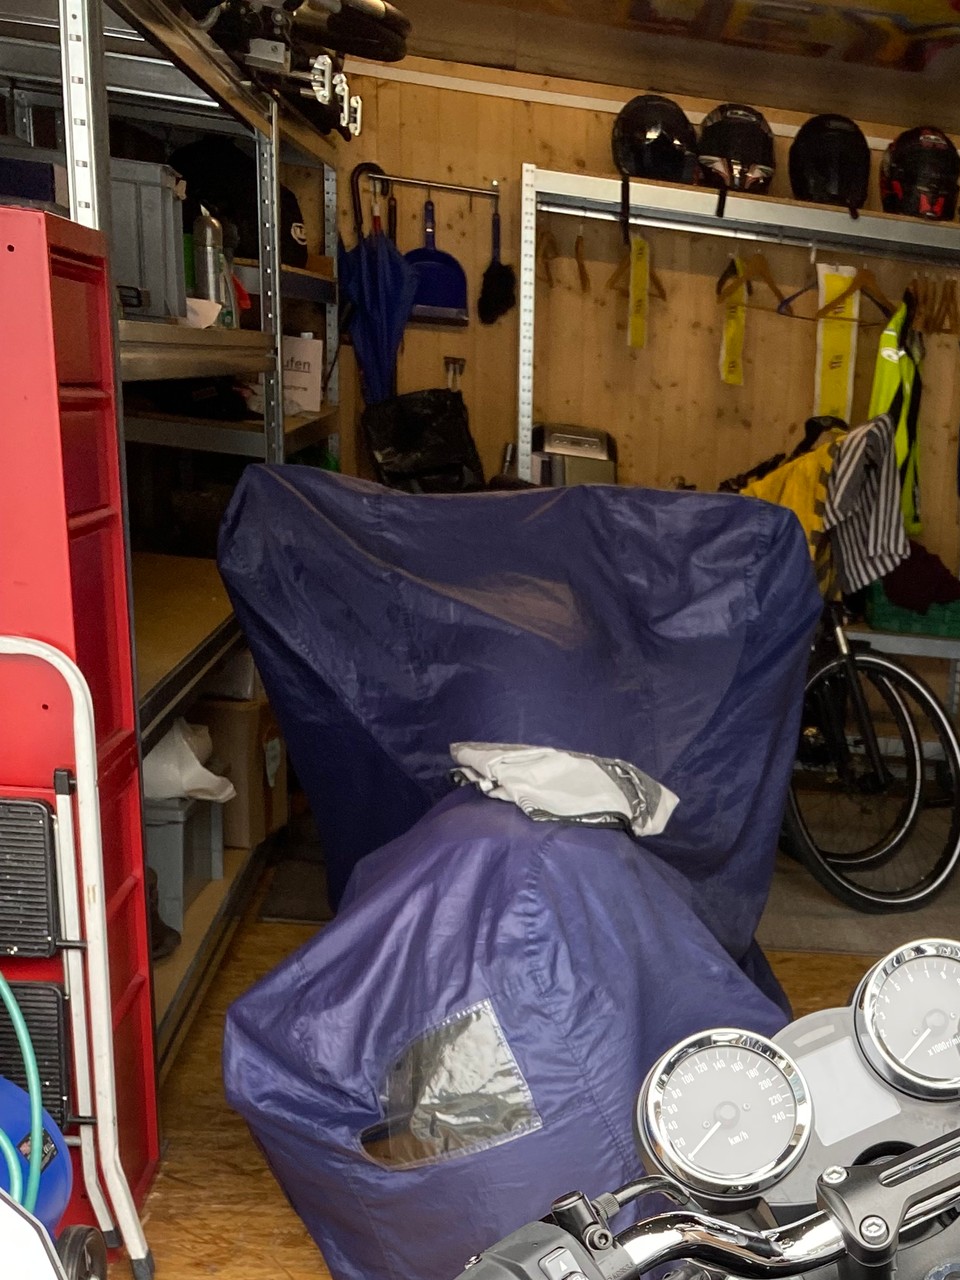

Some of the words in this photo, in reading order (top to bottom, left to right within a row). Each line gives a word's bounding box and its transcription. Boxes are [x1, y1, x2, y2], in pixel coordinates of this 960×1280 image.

[695, 1063, 708, 1073] 120
[713, 1059, 726, 1070] 140
[731, 1062, 744, 1072] 160
[682, 1074, 694, 1085] 100
[746, 1069, 759, 1079] 180
[759, 1080, 772, 1091] 200
[671, 1089, 682, 1099] 80
[769, 1094, 782, 1105] 220
[668, 1104, 679, 1115] 60
[773, 1111, 786, 1123] 240
[668, 1119, 679, 1130] 40
[675, 1137, 685, 1148] 20
[728, 1131, 749, 1145] km/h
